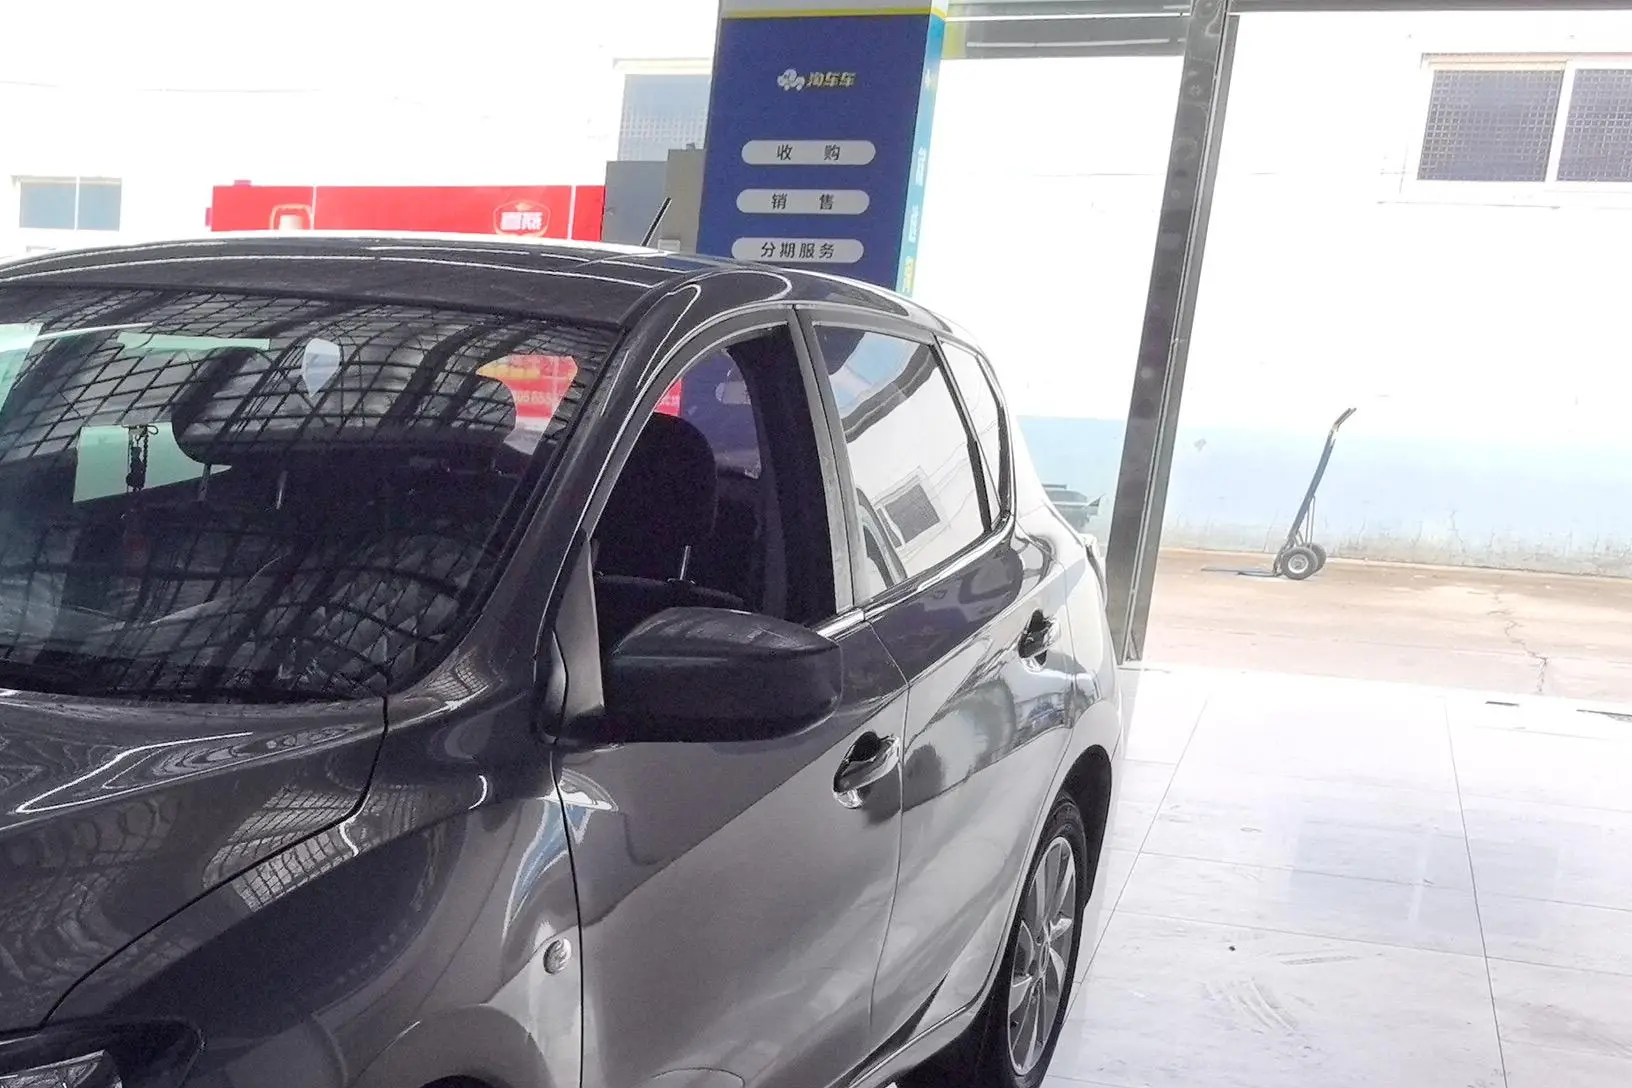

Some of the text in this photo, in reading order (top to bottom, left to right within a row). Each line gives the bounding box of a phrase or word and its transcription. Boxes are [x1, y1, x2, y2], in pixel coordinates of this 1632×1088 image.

[806, 71, 857, 88] 淘车车
[776, 144, 841, 161] 收购
[771, 194, 835, 211] 销售
[760, 242, 835, 259] 分期服务
